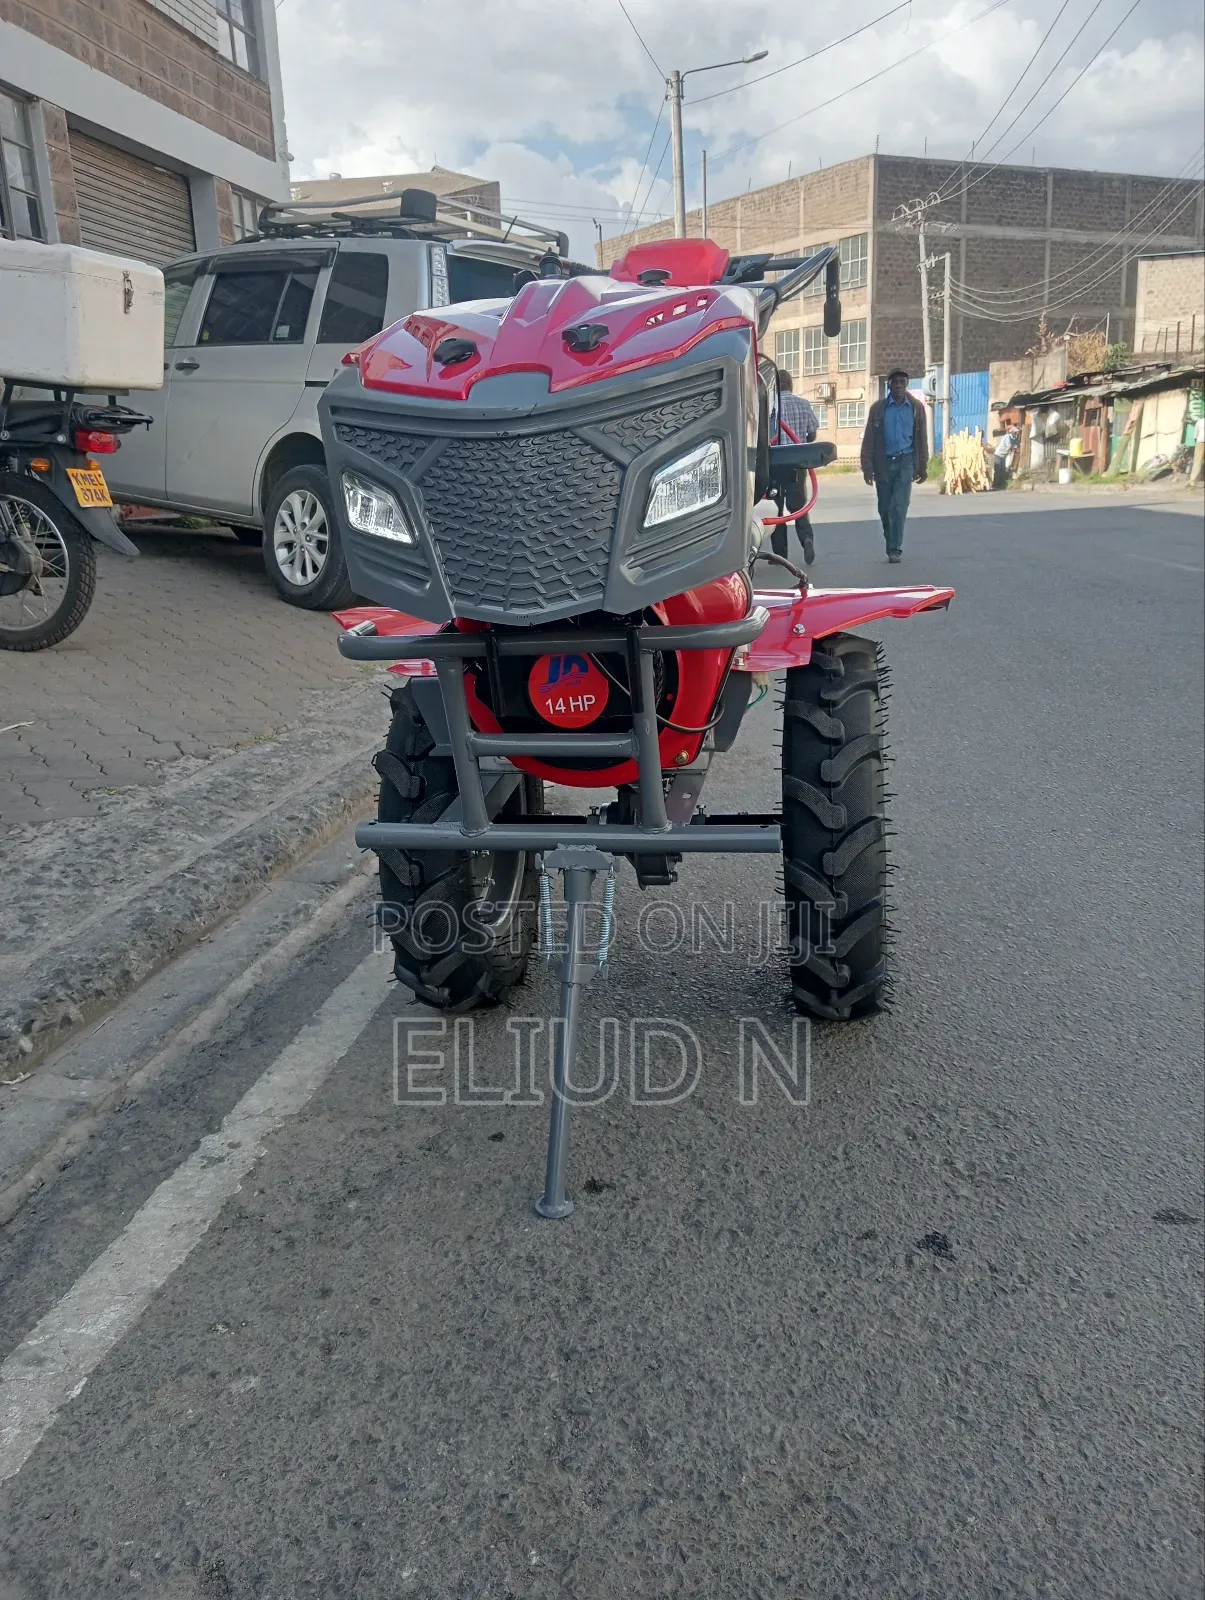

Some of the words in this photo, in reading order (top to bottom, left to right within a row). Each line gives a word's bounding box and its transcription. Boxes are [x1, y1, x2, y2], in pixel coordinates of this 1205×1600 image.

[71, 472, 104, 486] KMEL
[545, 697, 566, 715] 14
[569, 694, 596, 713] HP
